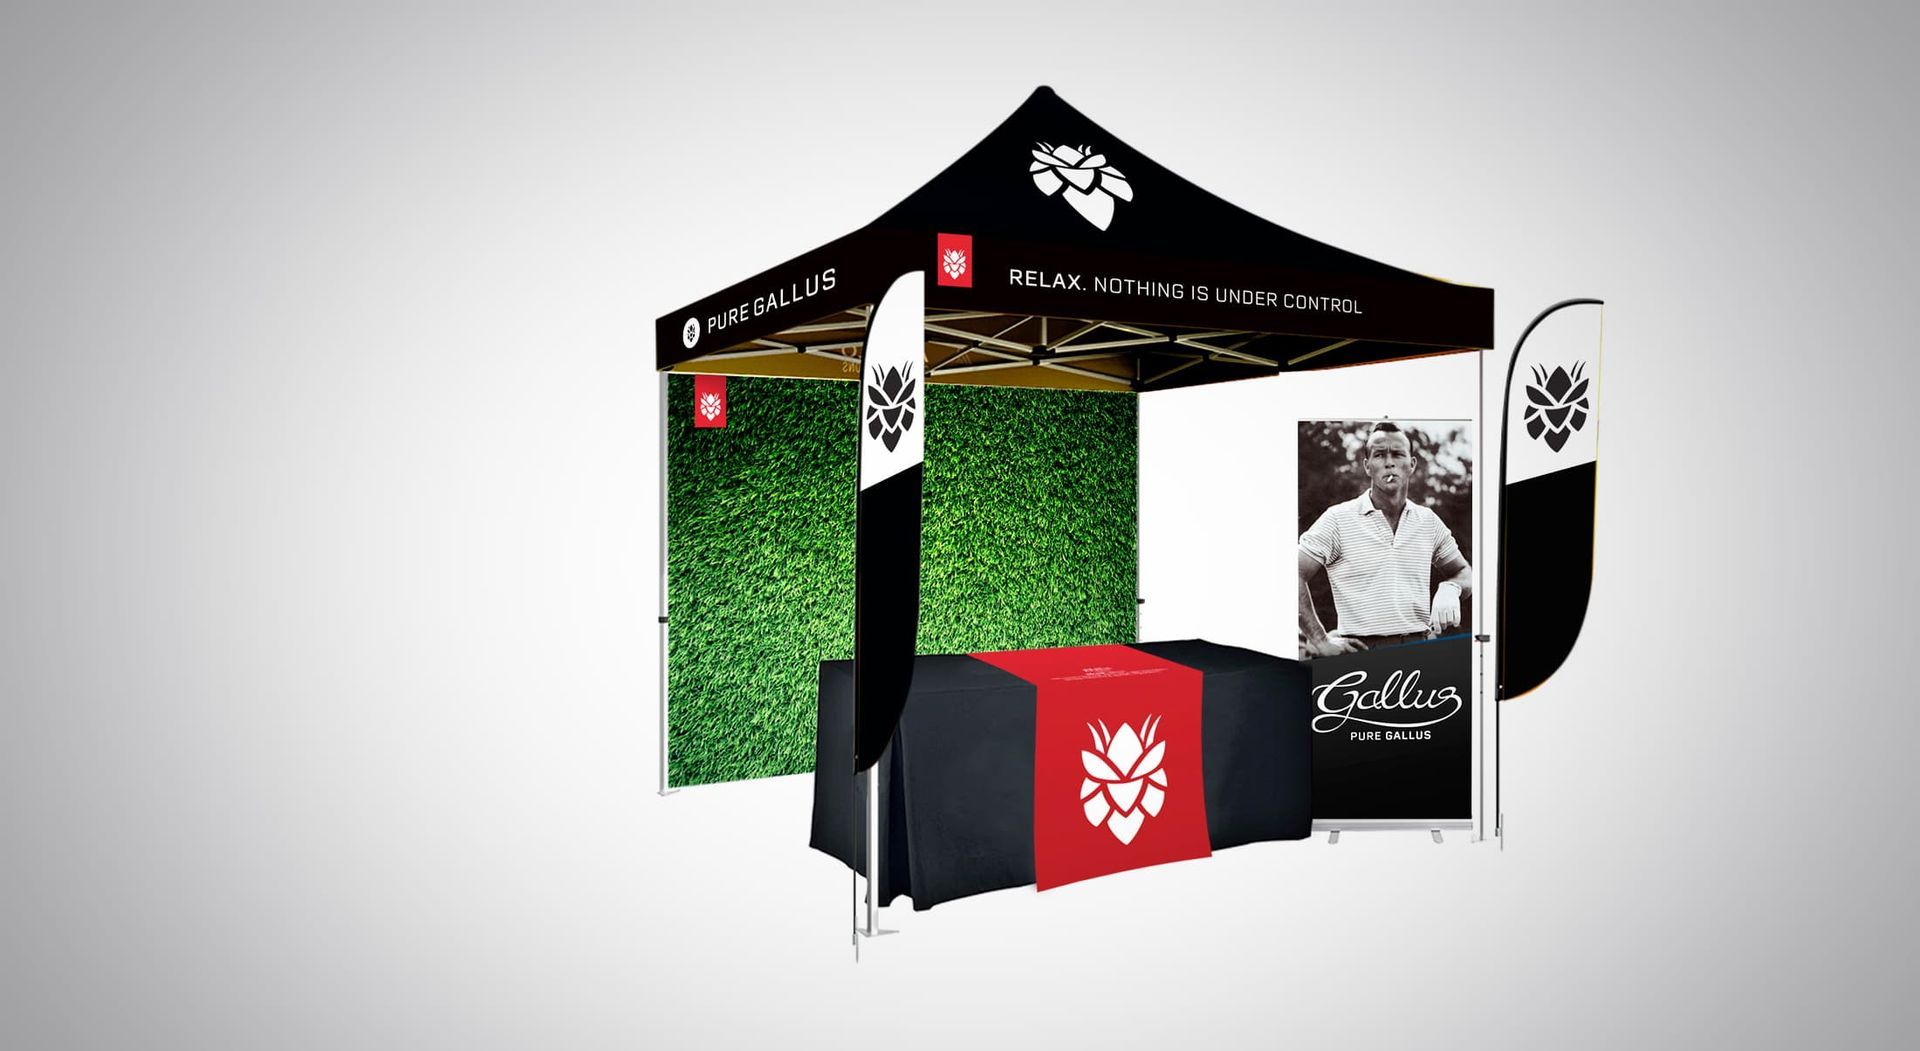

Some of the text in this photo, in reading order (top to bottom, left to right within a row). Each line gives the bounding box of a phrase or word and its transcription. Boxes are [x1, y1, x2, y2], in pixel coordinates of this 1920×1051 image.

[708, 268, 836, 334] PURE GALLUS
[1009, 268, 1363, 314] RELAX. NOTHING IS UNDER CONTROL
[1311, 669, 1462, 733] Gallus
[1350, 730, 1432, 741] PURE GALLUS
